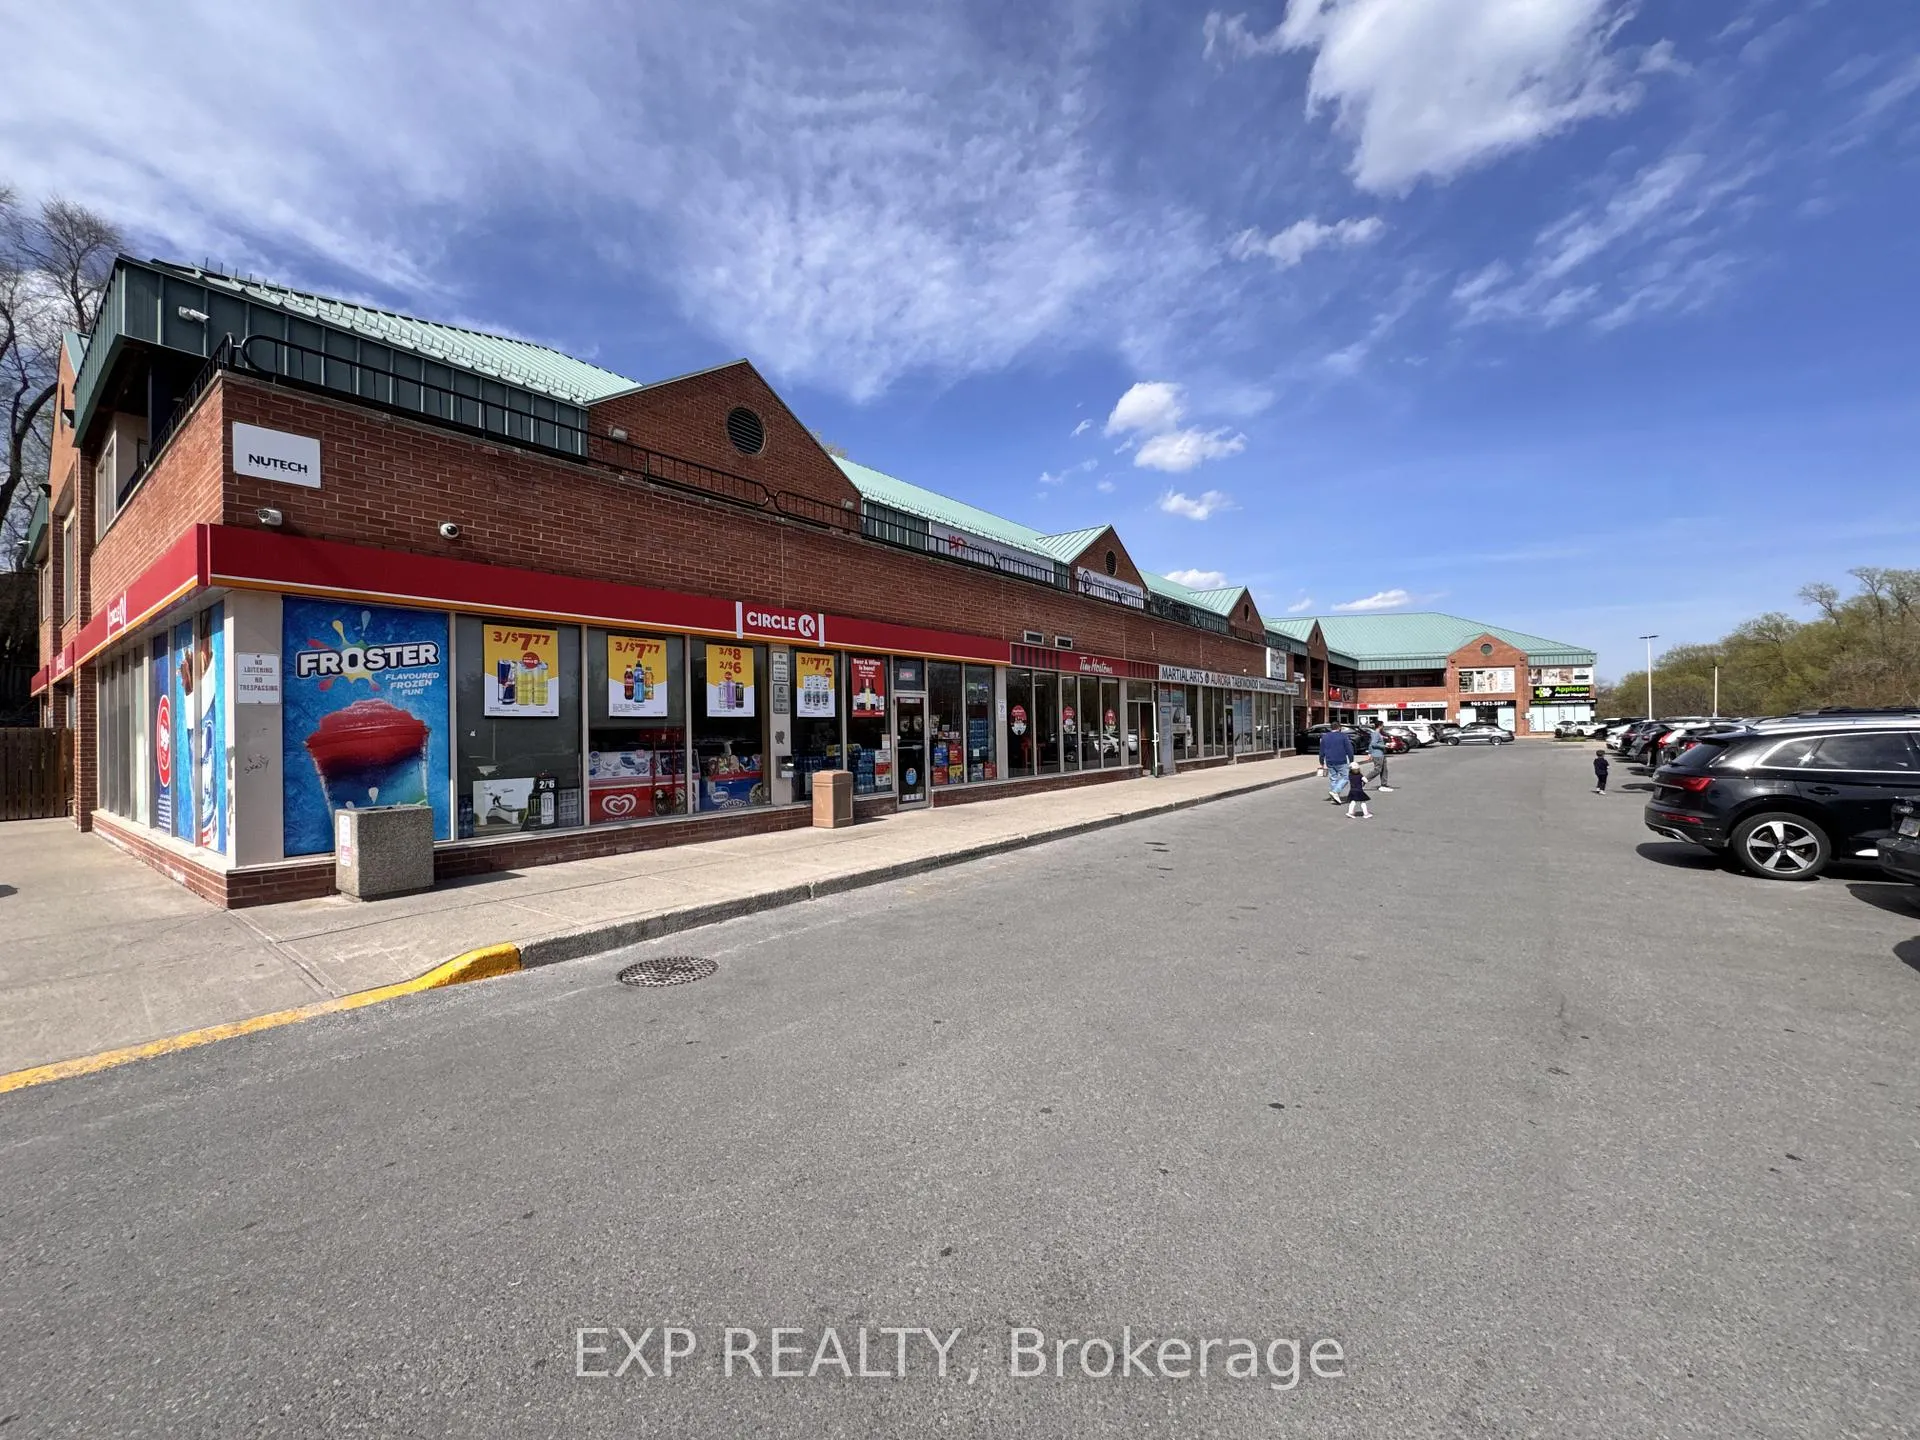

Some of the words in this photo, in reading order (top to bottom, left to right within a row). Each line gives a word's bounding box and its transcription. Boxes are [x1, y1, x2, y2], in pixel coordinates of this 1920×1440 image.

[248, 453, 308, 474] NUTECH
[746, 611, 796, 630] CIRCLE
[798, 614, 816, 637] K
[298, 643, 439, 678] FROSTER
[1080, 657, 1090, 671] Tim
[1091, 658, 1113, 674] Hortons
[385, 672, 439, 681] FLAVOURED
[390, 679, 432, 690] FROZEN
[1161, 667, 1188, 682] MARTIAL
[1190, 670, 1204, 684] ARTS
[1211, 673, 1232, 687] AURORA
[402, 688, 424, 696] FUN!
[1554, 686, 1590, 694] Appleton
